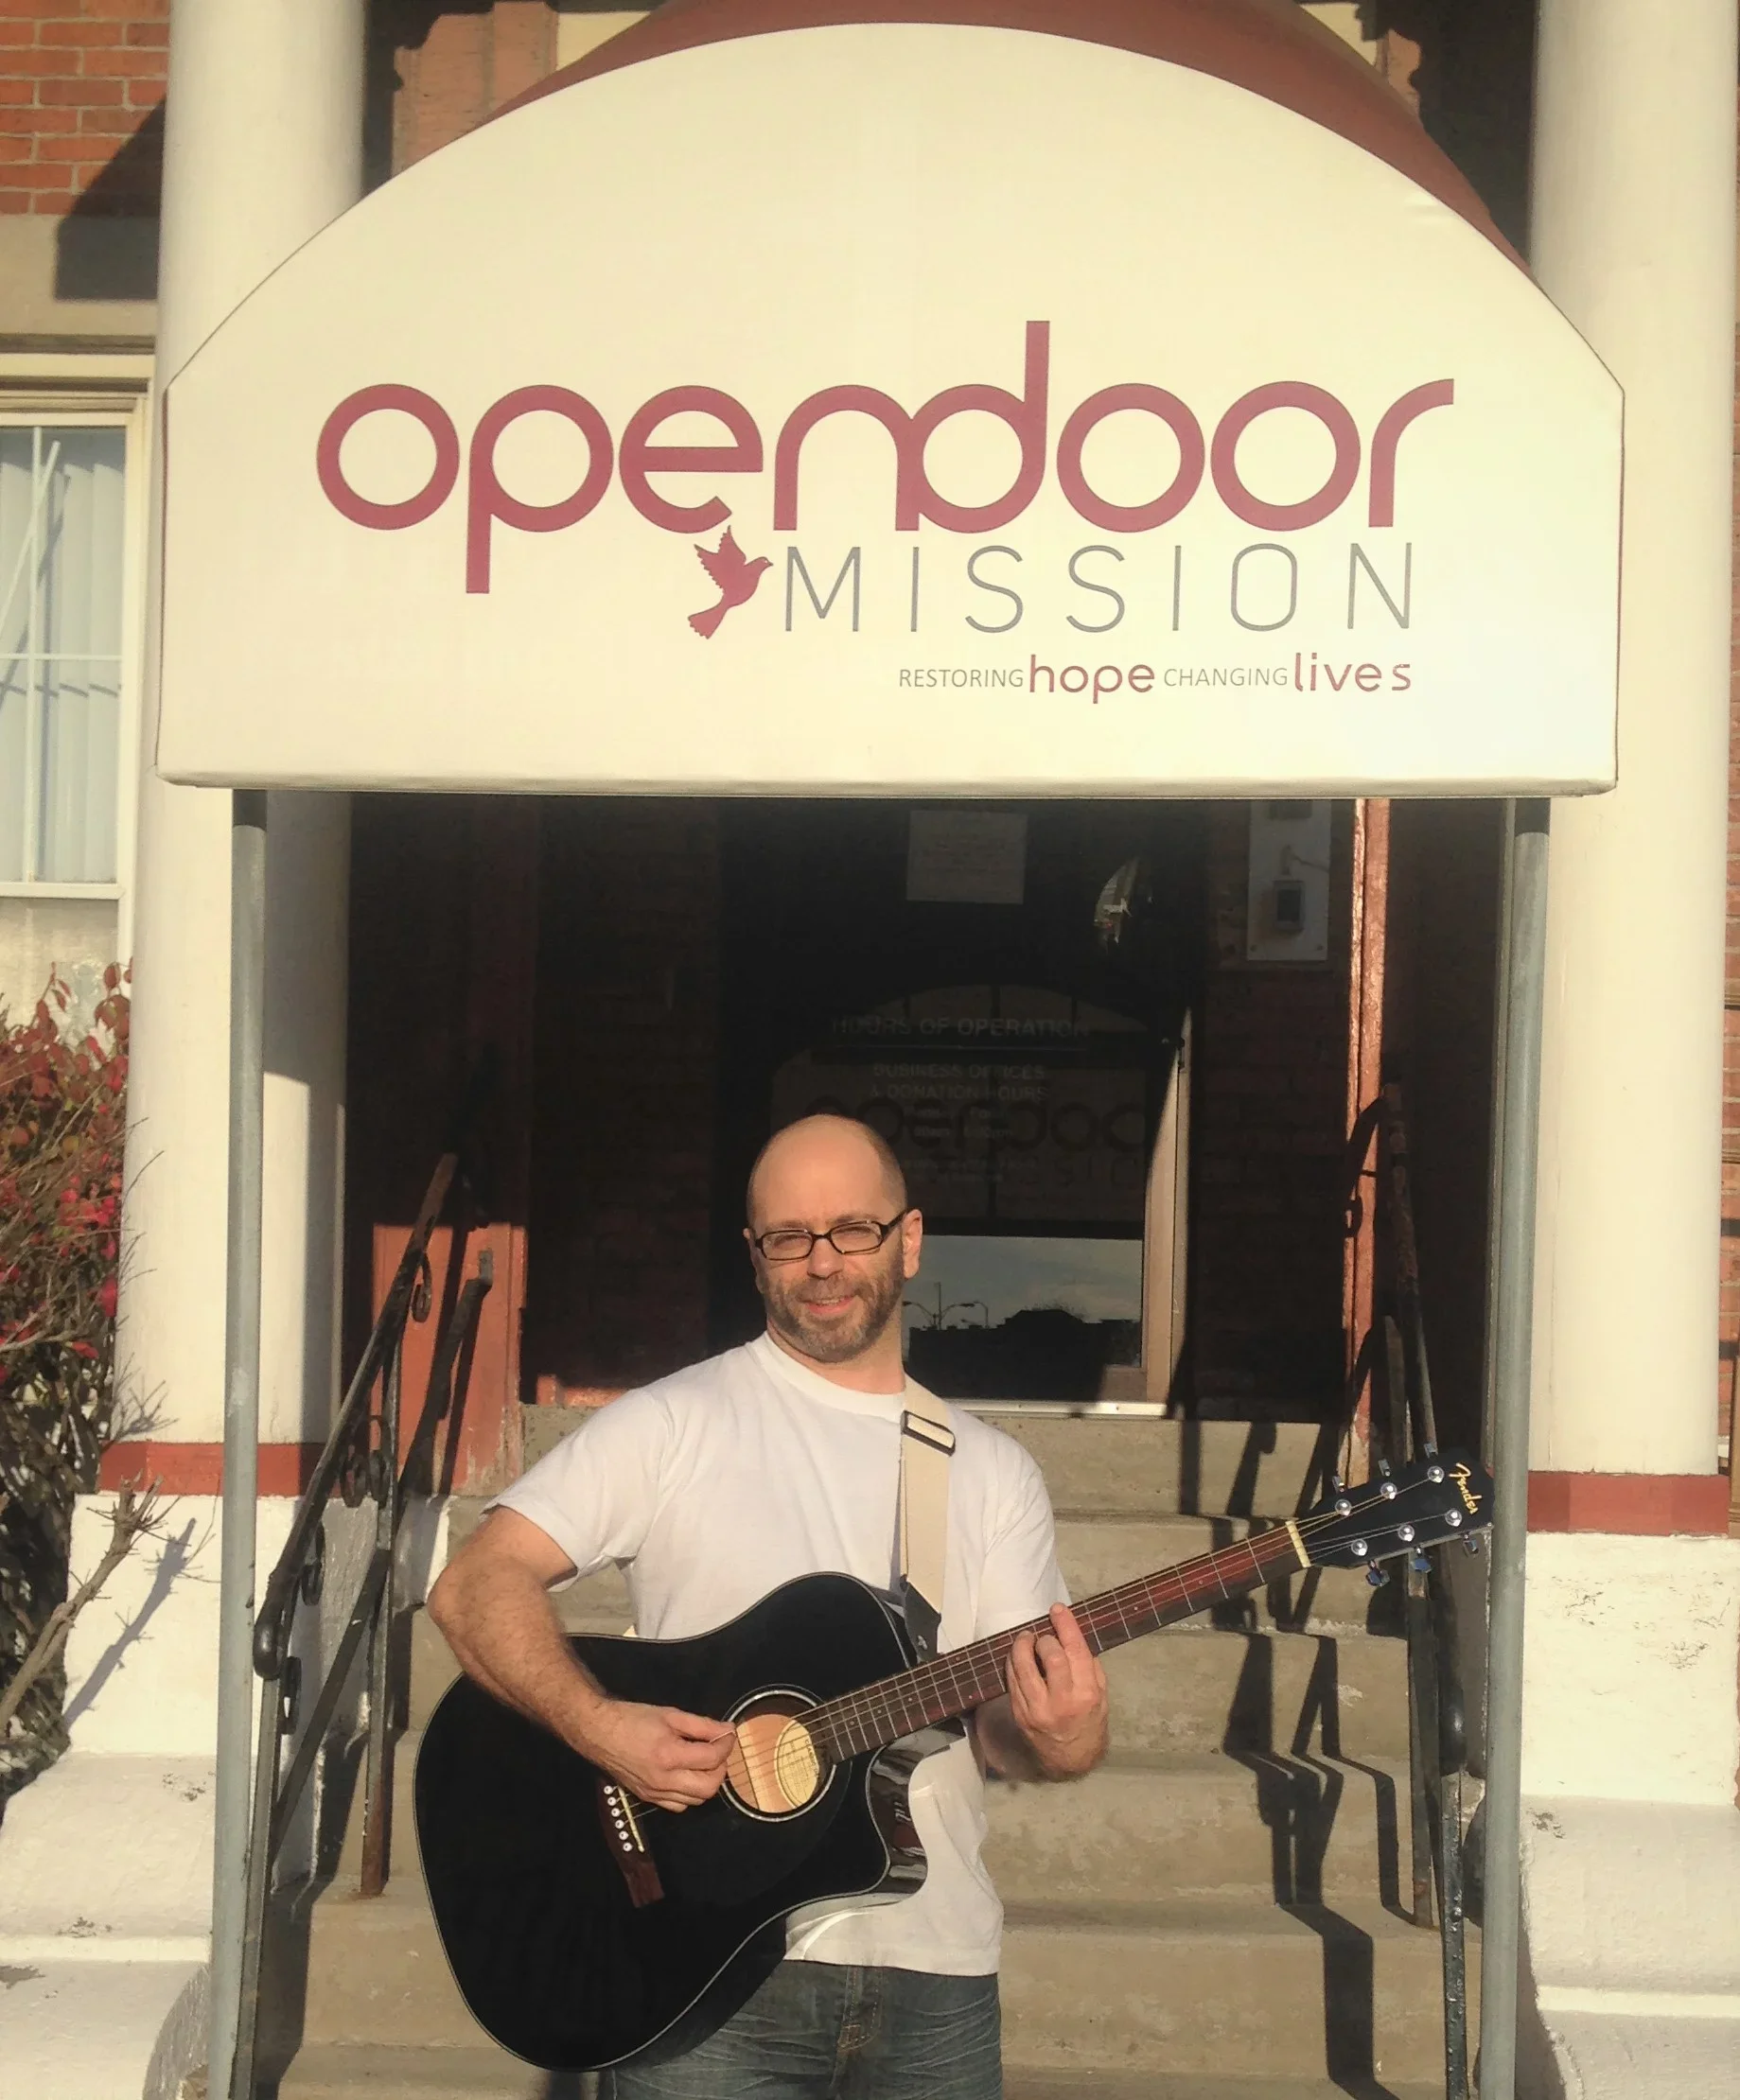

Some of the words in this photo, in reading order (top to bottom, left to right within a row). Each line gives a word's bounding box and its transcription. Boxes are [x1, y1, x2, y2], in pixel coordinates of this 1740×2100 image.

[785, 542, 1412, 634] MISSION
[899, 668, 1024, 689] RESTORING
[1029, 654, 1155, 704] hope
[1163, 667, 1289, 688] CHANGING
[1293, 652, 1412, 692] lives
[920, 1018, 950, 1036] OF
[958, 1018, 1091, 1039] OPERATION
[968, 1063, 1046, 1080] OFICES
[1449, 1462, 1483, 1514] Fender
